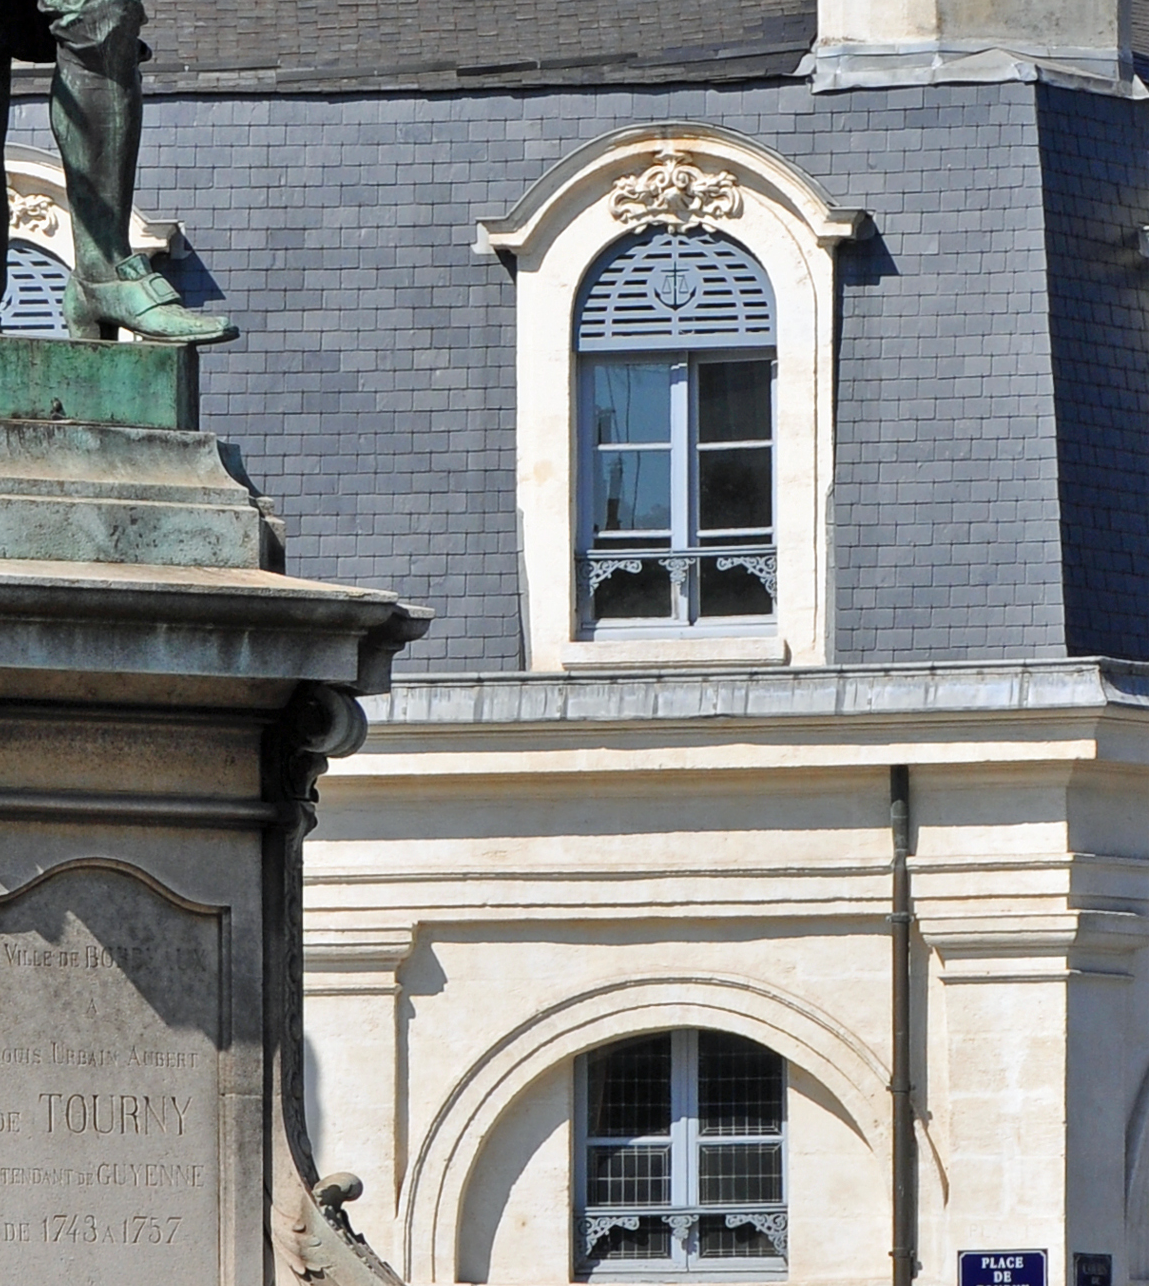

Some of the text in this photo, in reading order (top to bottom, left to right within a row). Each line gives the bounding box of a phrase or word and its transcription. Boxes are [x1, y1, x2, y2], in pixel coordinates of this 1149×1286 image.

[3, 943, 52, 967] VILLE
[59, 952, 79, 967] DE
[50, 1041, 120, 1067] URBAIN
[127, 1045, 199, 1069] AUBERT
[38, 1093, 193, 1136] TOURNY
[77, 1171, 94, 1186] DE
[97, 1163, 205, 1188] GUYENNE
[3, 1214, 184, 1245] DE 1743 A 1757
[981, 1256, 1024, 1269] PLACE
[993, 1271, 1012, 1283] DE
